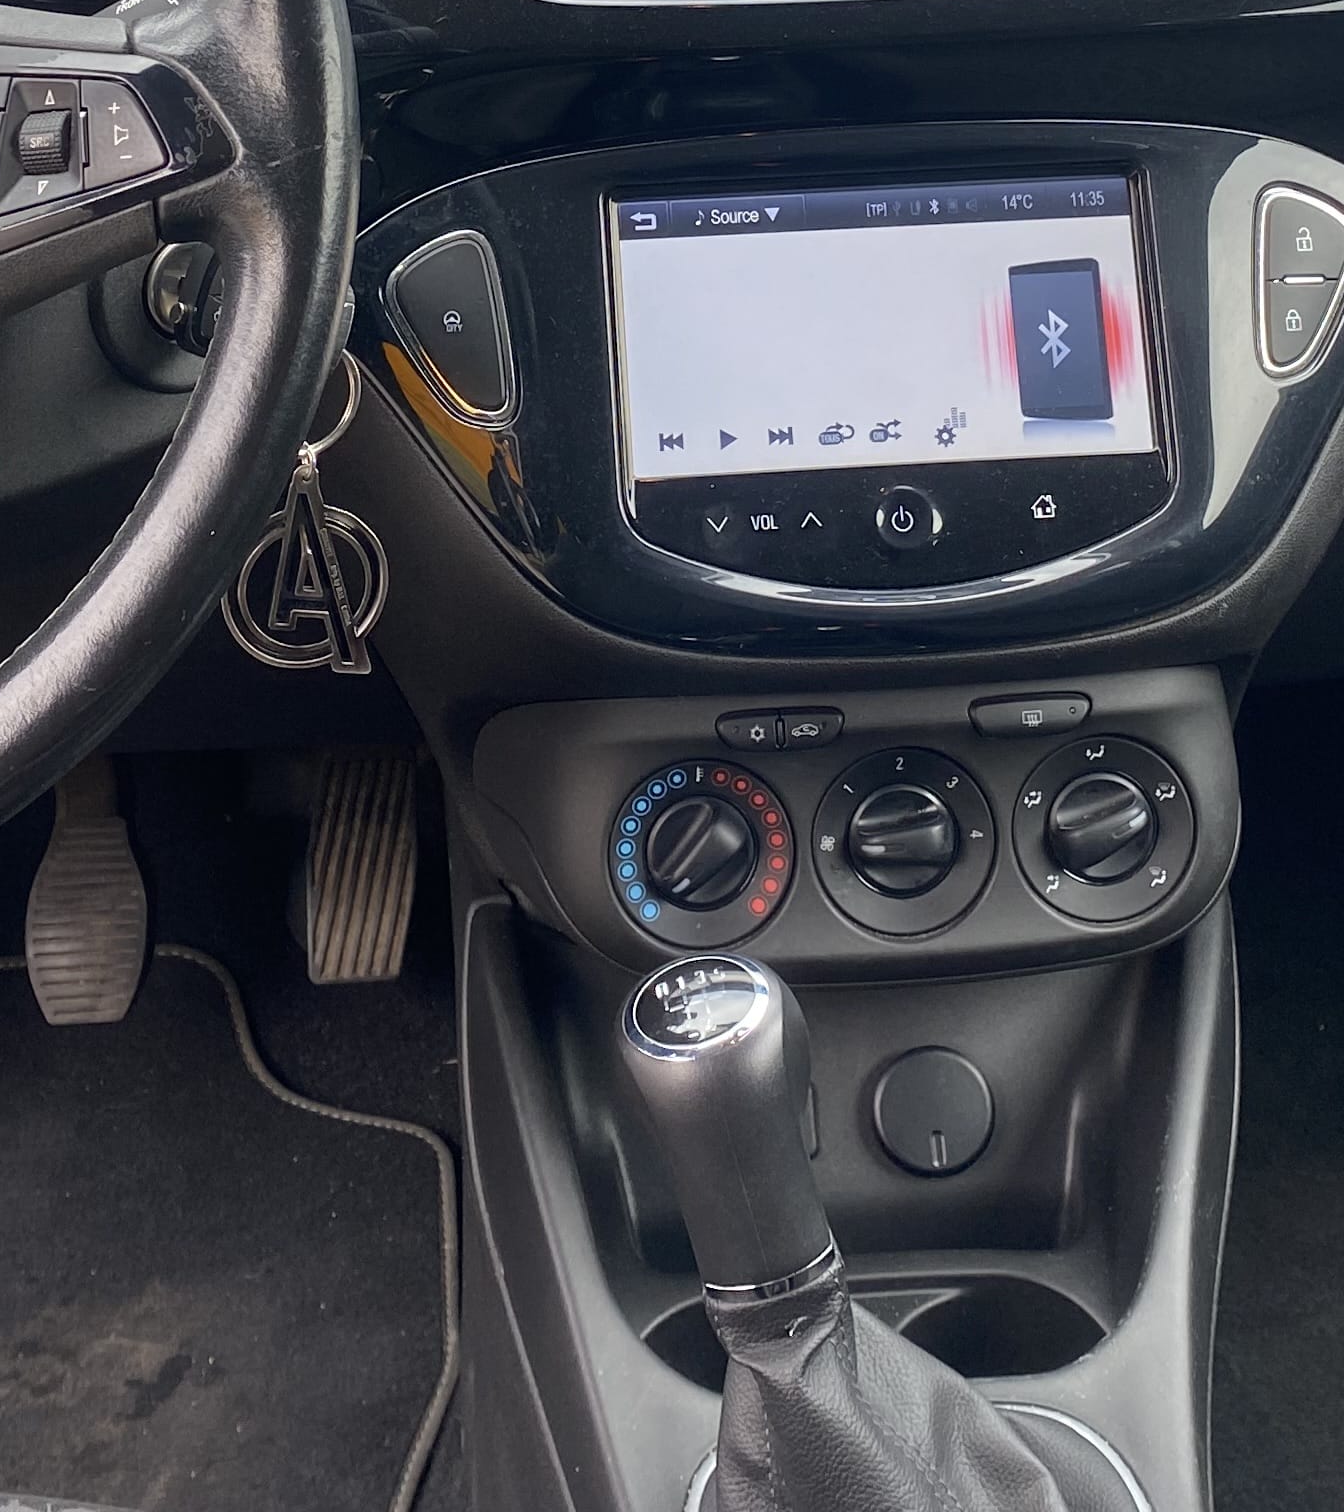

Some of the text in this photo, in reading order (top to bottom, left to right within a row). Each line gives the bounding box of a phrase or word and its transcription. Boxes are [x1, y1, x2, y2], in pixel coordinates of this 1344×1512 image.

[710, 209, 760, 225] Source
[1002, 194, 1033, 210] 14°C
[750, 514, 779, 530] VOL
[895, 756, 904, 770] 2
[843, 783, 854, 794] 1
[946, 776, 959, 788] 3
[970, 829, 984, 839] 4
